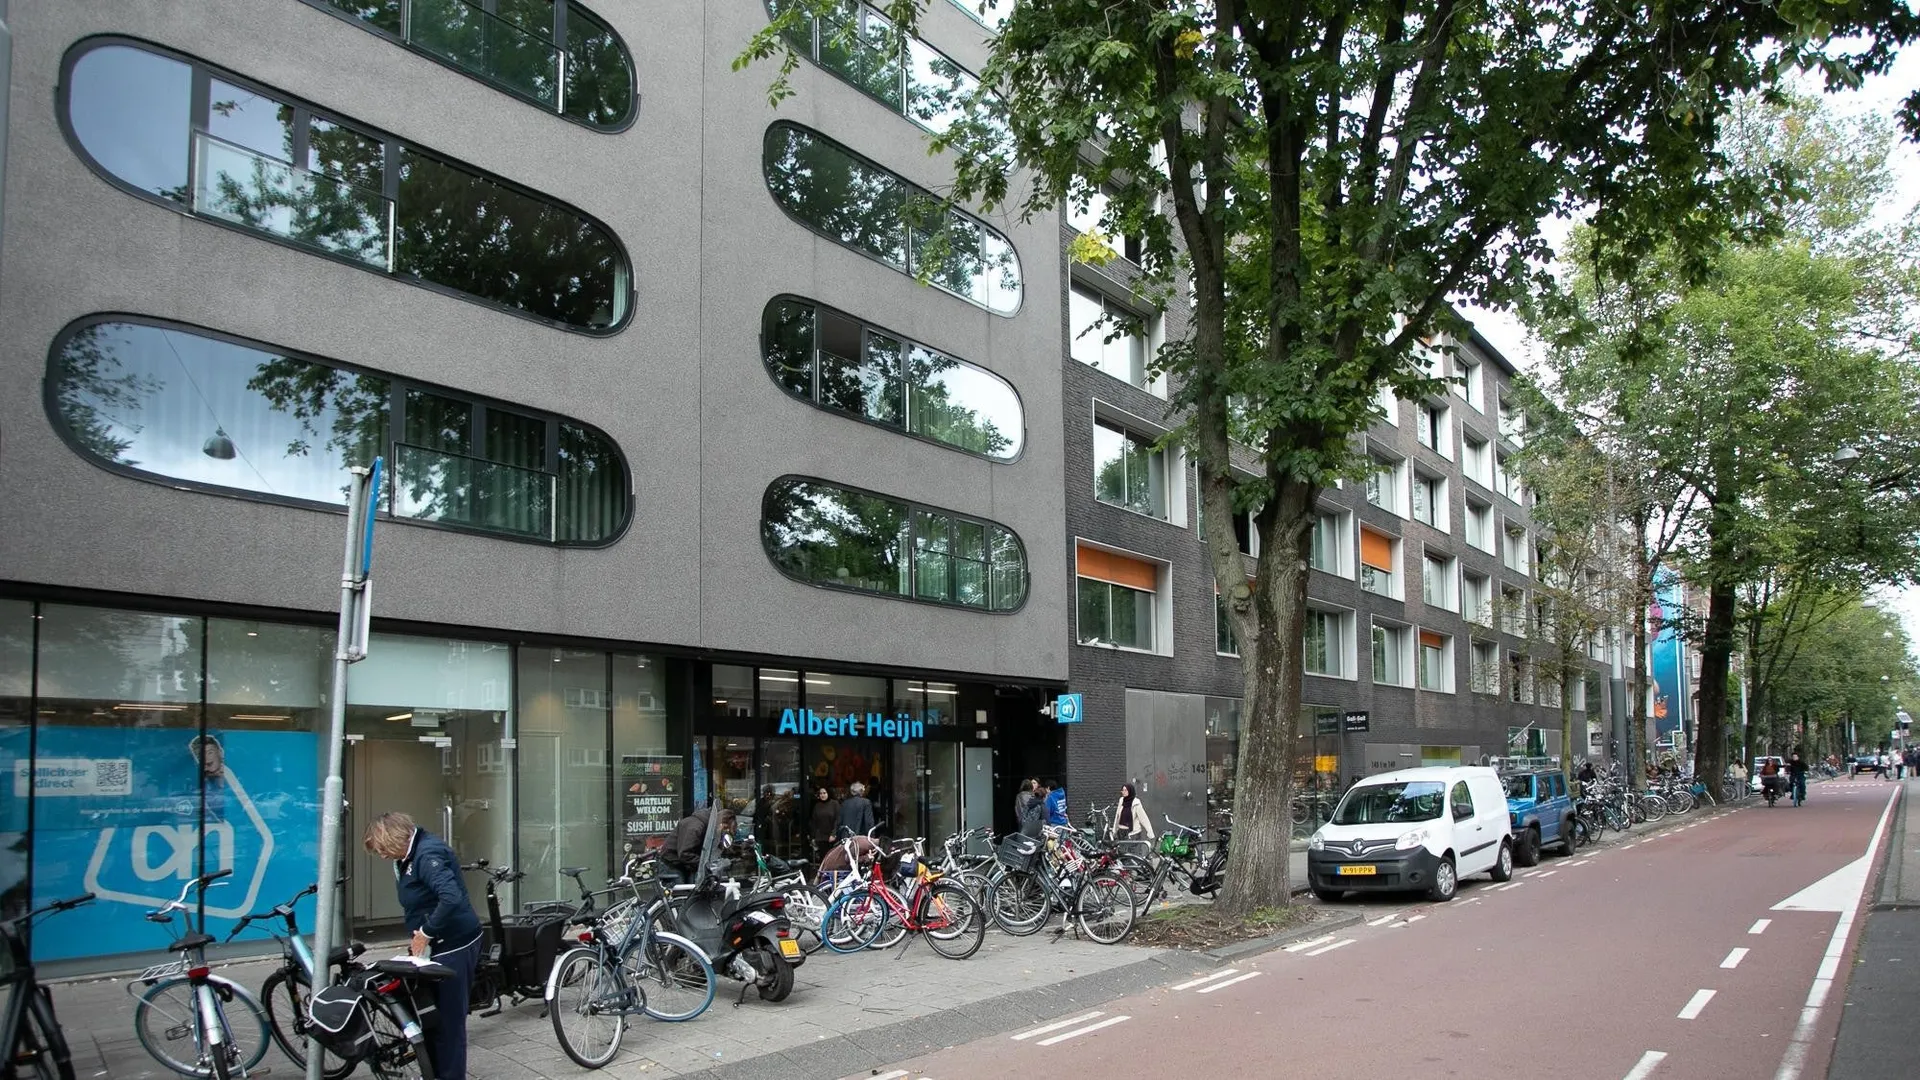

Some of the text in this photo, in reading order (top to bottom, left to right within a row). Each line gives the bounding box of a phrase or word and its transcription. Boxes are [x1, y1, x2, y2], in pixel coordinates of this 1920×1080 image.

[778, 708, 924, 743] Albert Heijn
[1192, 764, 1205, 773] 143
[35, 778, 75, 788] direct
[633, 797, 673, 806] HARTELIJK
[636, 806, 670, 814] WELKOM
[627, 820, 679, 832] SUSHI DAILY
